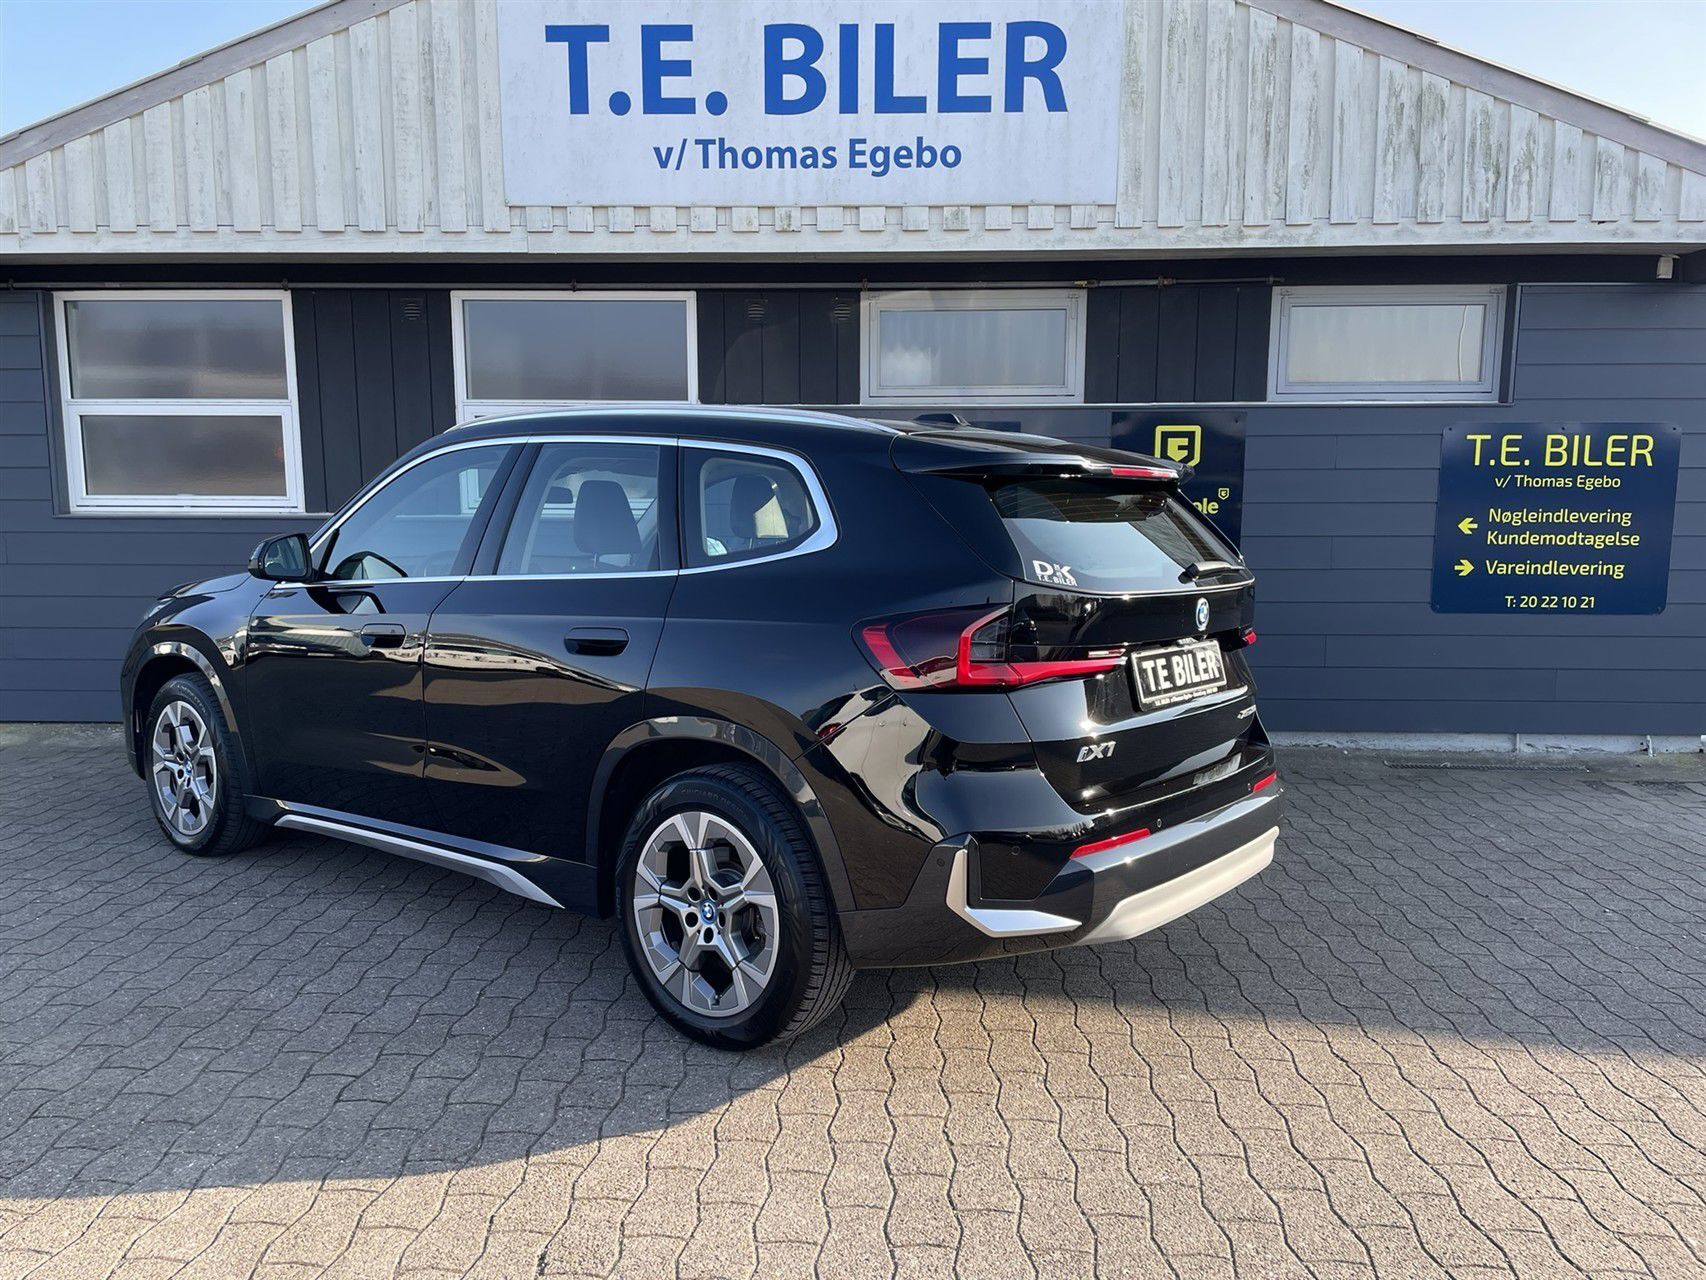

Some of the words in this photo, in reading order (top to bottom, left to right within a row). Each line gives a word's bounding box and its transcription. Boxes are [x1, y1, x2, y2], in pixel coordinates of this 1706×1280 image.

[545, 24, 728, 115] T.E.
[764, 20, 1068, 115] BILER
[653, 138, 688, 170] v/
[694, 138, 837, 170] Thomas
[848, 137, 962, 178] Egebo
[1466, 434, 1530, 466] T.E.
[1545, 434, 1654, 467] BILER
[1495, 475, 1511, 488] v/
[1515, 475, 1573, 488] Thomas
[1576, 475, 1621, 490] Egebo
[1488, 508, 1632, 526] Nøgleindlevering
[1487, 530, 1640, 549] Kundemodtagelse
[1485, 559, 1625, 579] Vareindlevering
[1505, 596, 1517, 608] T:
[1520, 596, 1538, 608] 20
[1541, 596, 1558, 608] 22
[1561, 596, 1577, 608] 10
[1580, 596, 1595, 608] 21
[1171, 650, 1220, 687] BILER
